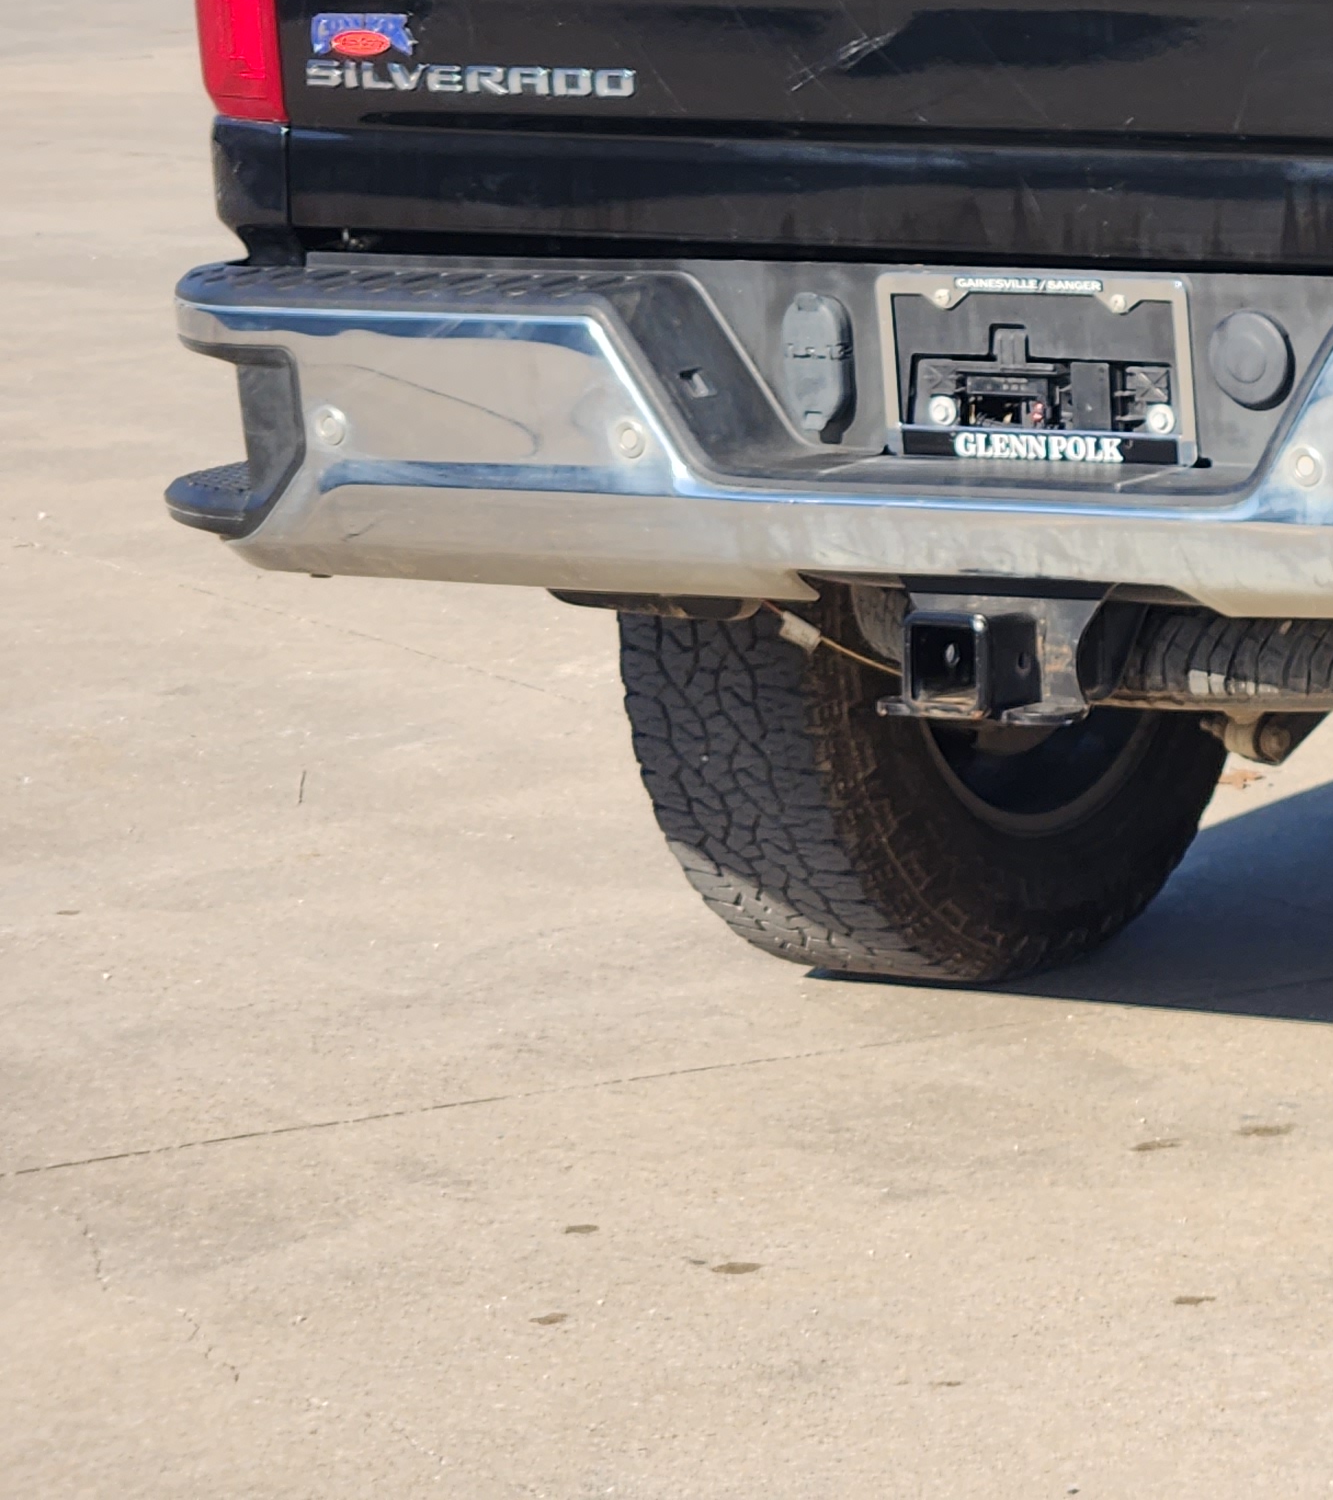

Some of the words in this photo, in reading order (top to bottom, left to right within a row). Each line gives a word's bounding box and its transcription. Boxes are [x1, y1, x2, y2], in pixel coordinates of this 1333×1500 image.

[305, 58, 638, 99] SILVERADO
[955, 277, 1038, 290] GAINESVILLE
[1046, 280, 1102, 291] SANGER
[953, 432, 1047, 461] GLENN
[1047, 435, 1125, 463] POLK
